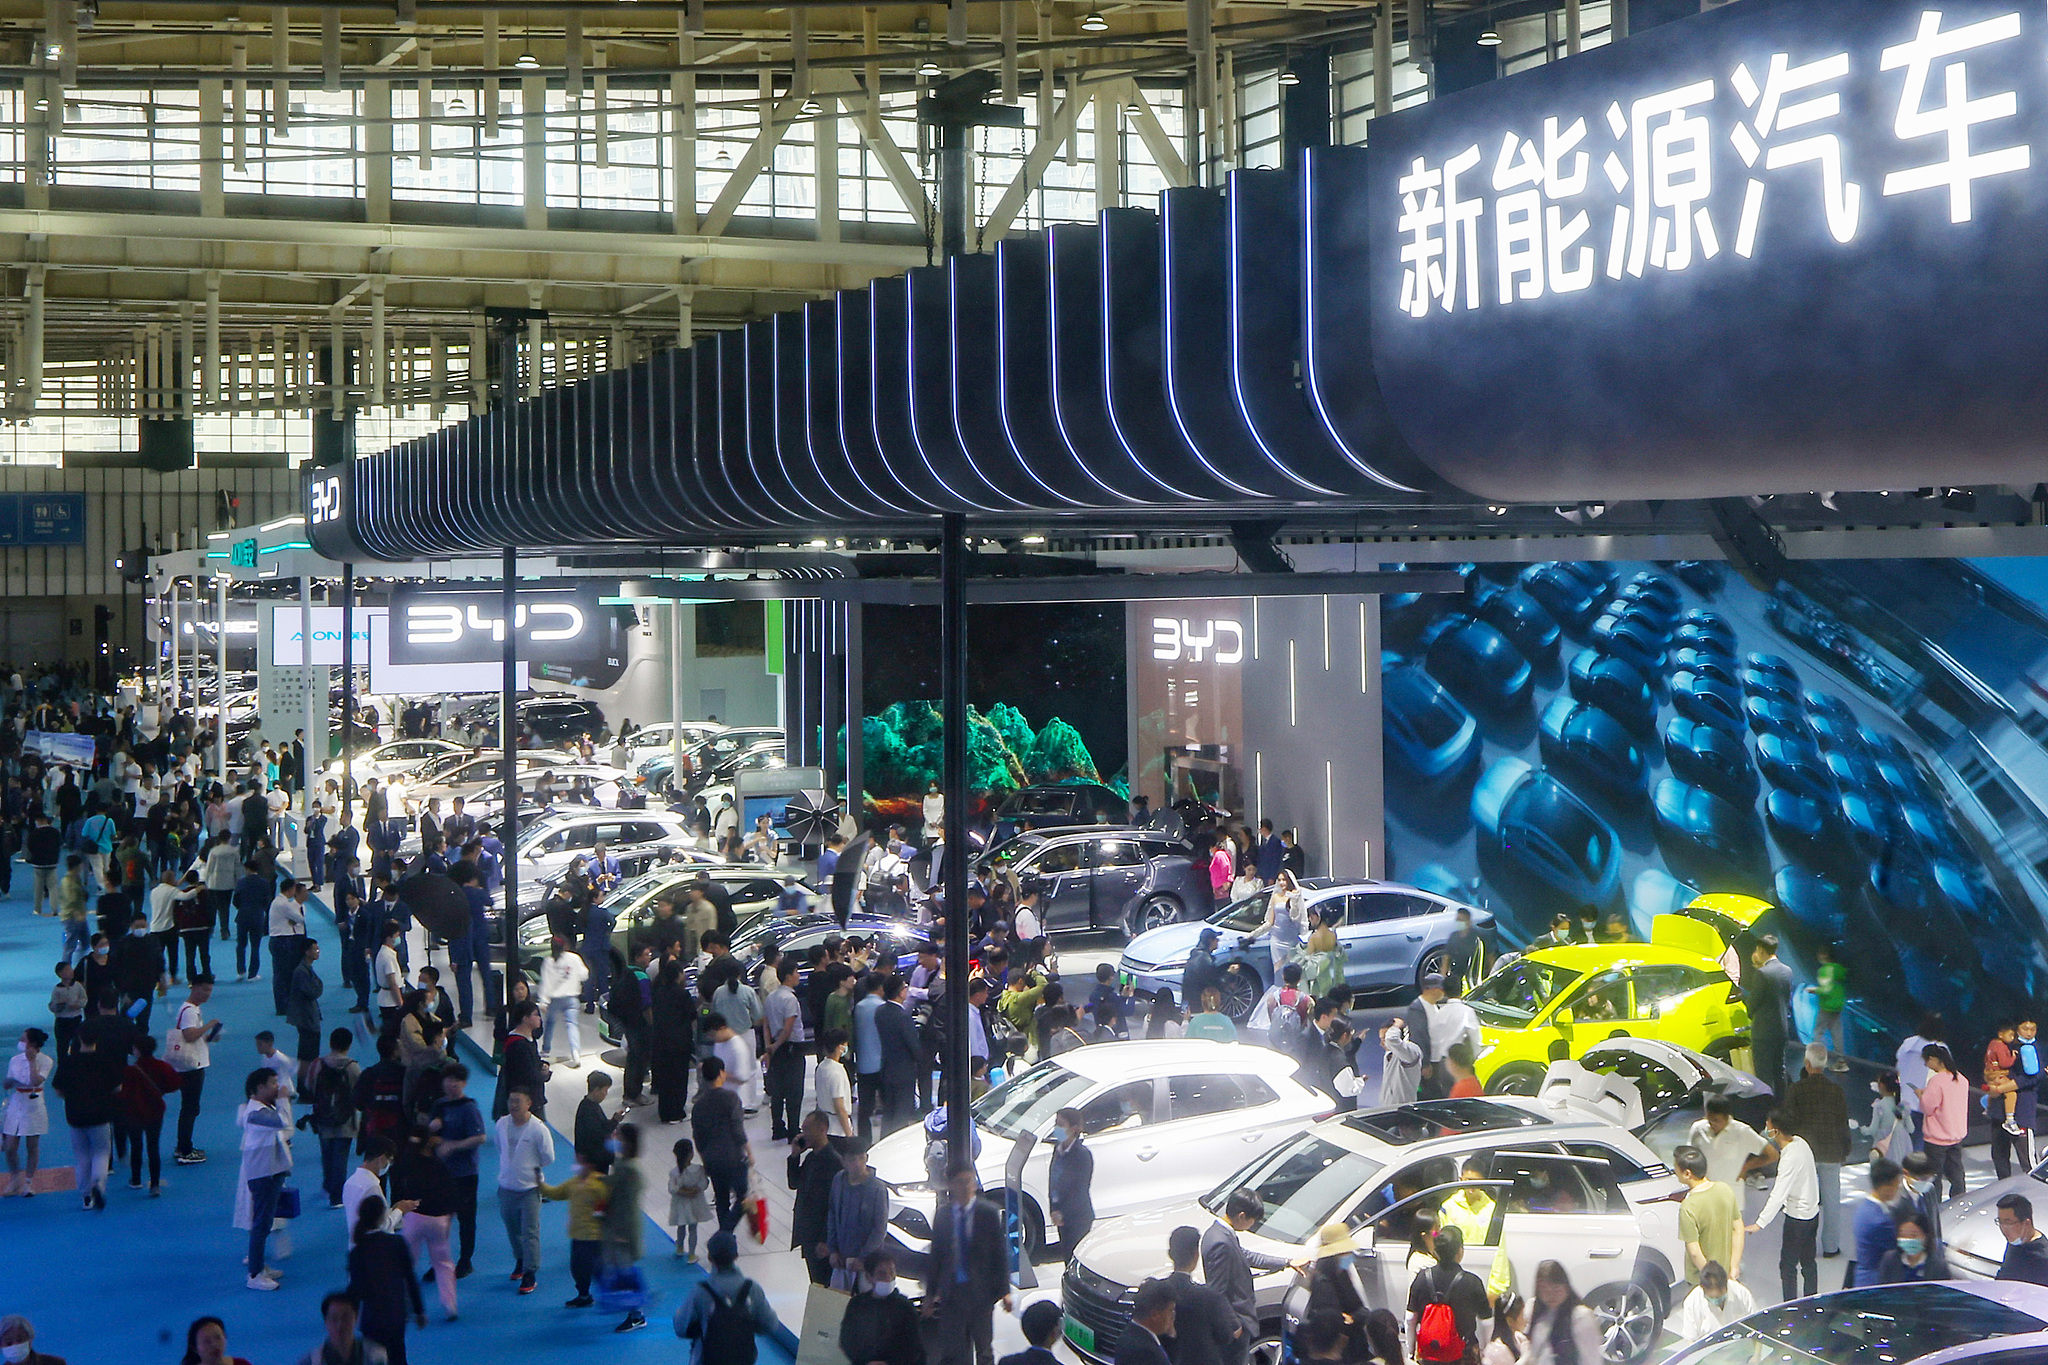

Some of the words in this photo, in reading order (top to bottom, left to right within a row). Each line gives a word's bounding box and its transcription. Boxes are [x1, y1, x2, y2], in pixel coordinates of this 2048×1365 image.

[1398, 10, 2030, 317] 新能源汽车
[311, 476, 340, 524] BYD
[290, 631, 342, 640] AON
[407, 603, 584, 644] BYD
[1152, 617, 1243, 664] BYD
